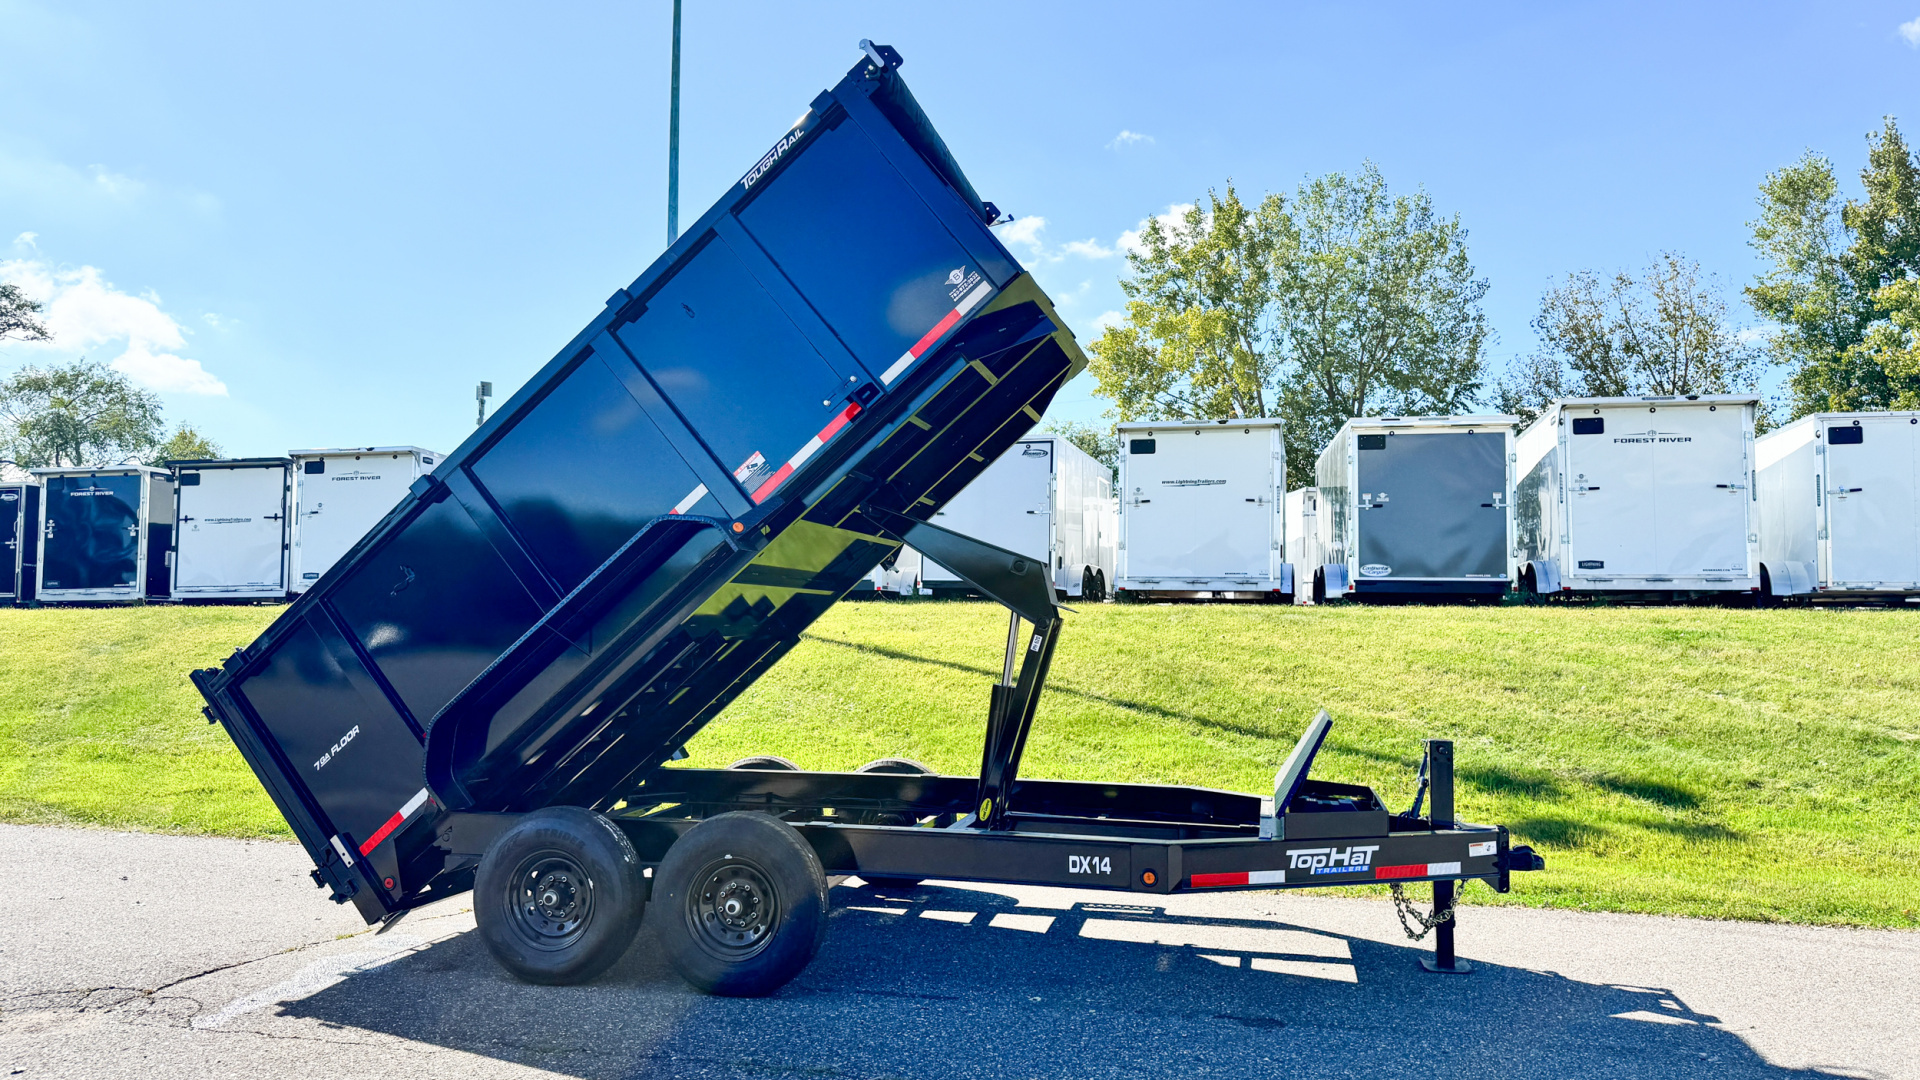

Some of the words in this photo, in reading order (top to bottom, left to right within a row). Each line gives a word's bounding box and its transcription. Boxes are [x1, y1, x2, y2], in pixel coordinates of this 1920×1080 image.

[331, 724, 360, 757] FLOOR
[1068, 855, 1112, 875] DX14
[1317, 865, 1369, 874] TRAILERS
